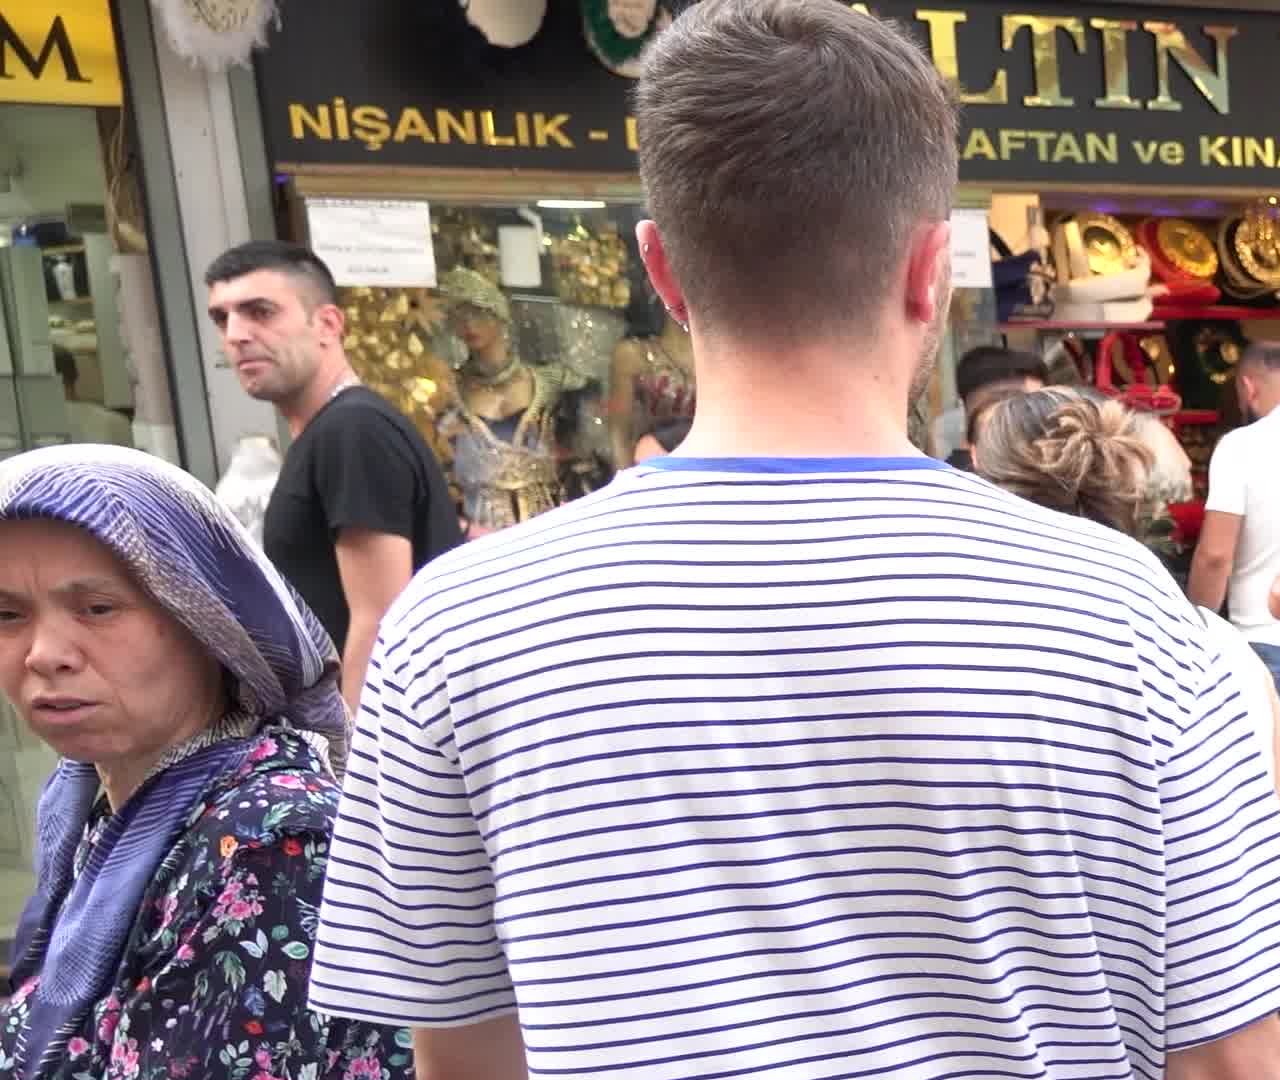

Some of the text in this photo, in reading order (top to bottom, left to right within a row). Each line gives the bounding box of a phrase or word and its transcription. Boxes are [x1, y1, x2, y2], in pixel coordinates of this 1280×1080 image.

[852, 2, 1239, 116] LTIN
[288, 96, 574, 151] NİŞANLIK
[956, 128, 1119, 164] AFTAN
[1132, 138, 1184, 167] ve
